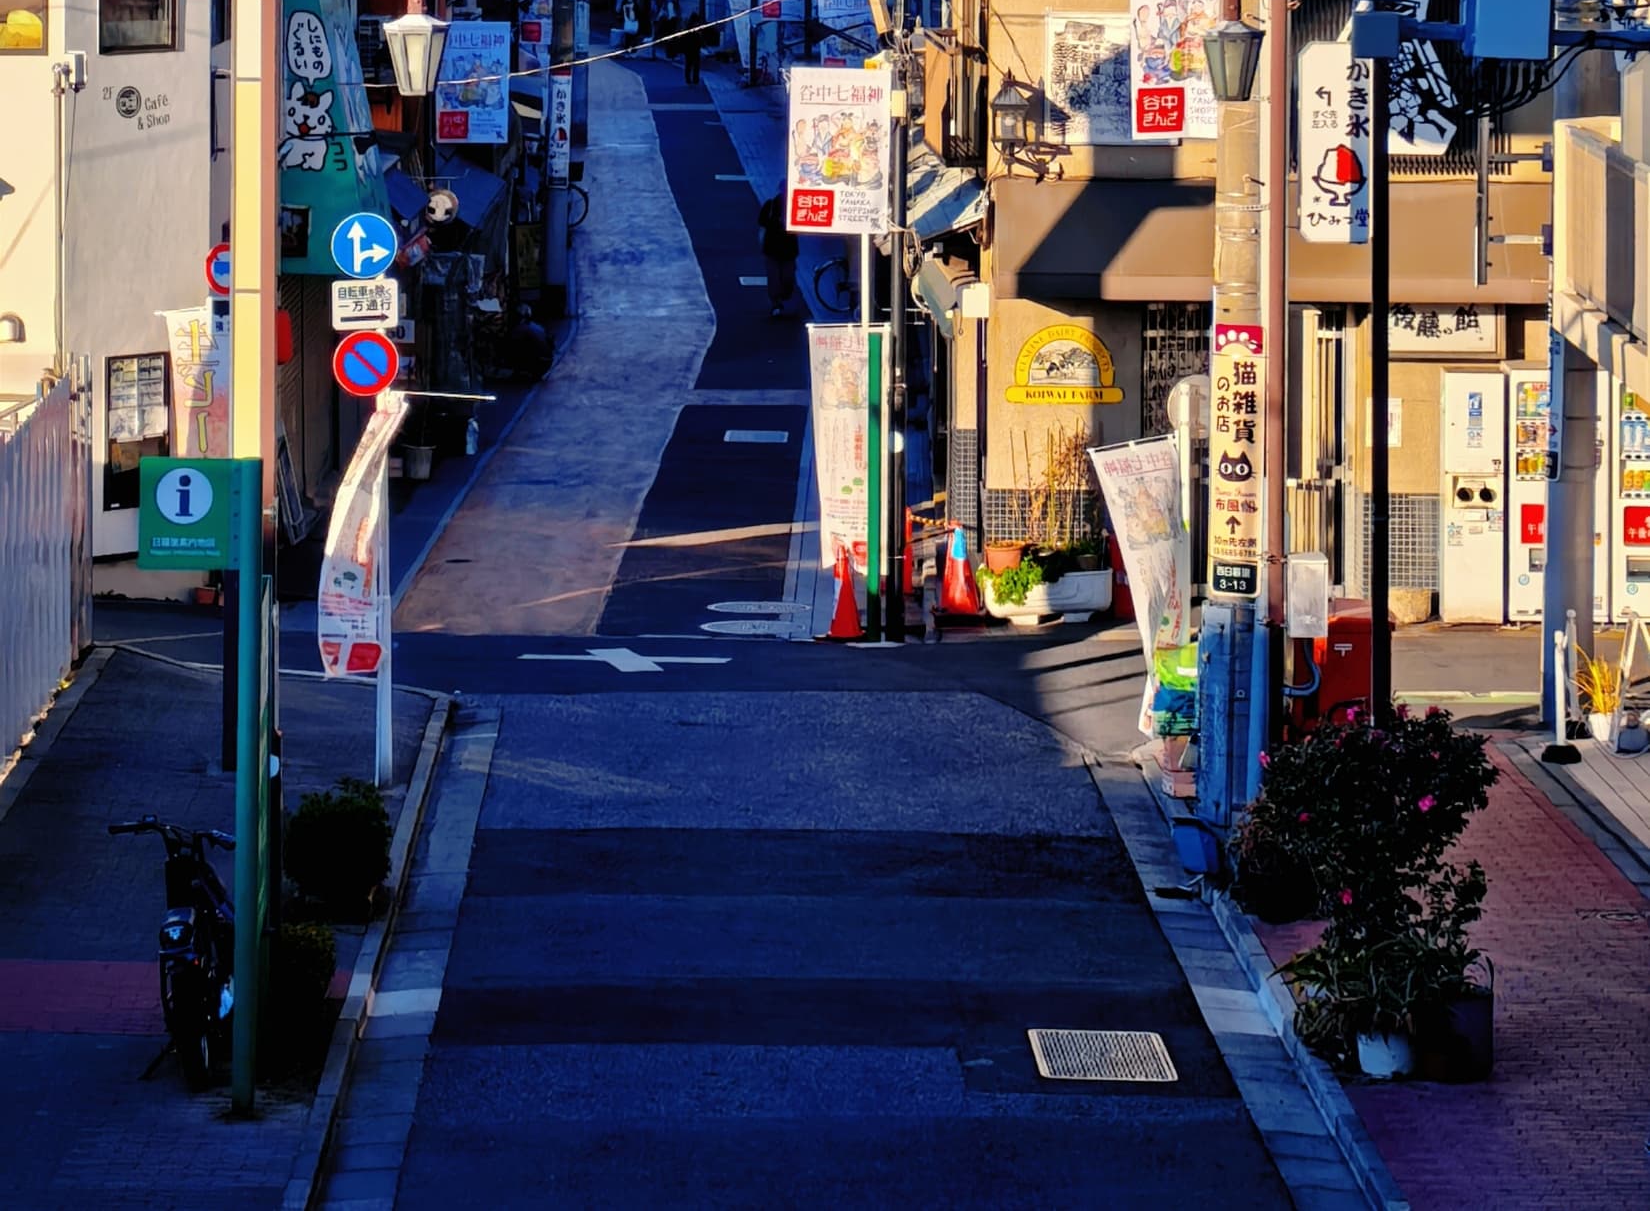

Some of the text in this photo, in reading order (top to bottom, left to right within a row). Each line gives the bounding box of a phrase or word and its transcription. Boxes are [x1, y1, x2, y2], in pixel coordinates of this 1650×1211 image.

[1142, 94, 1178, 111] 谷中
[1346, 60, 1370, 139] かき氷
[1142, 111, 1178, 128] ぎんざ
[796, 194, 829, 209] 谷中
[1306, 208, 1370, 228] ひみつ堂
[338, 299, 392, 312] 一方通行
[1026, 390, 1104, 401] KOIWAI FARM
[1232, 360, 1257, 445] 猫雑貨
[1216, 376, 1230, 433] のお店
[1219, 579, 1248, 590] 3-13
